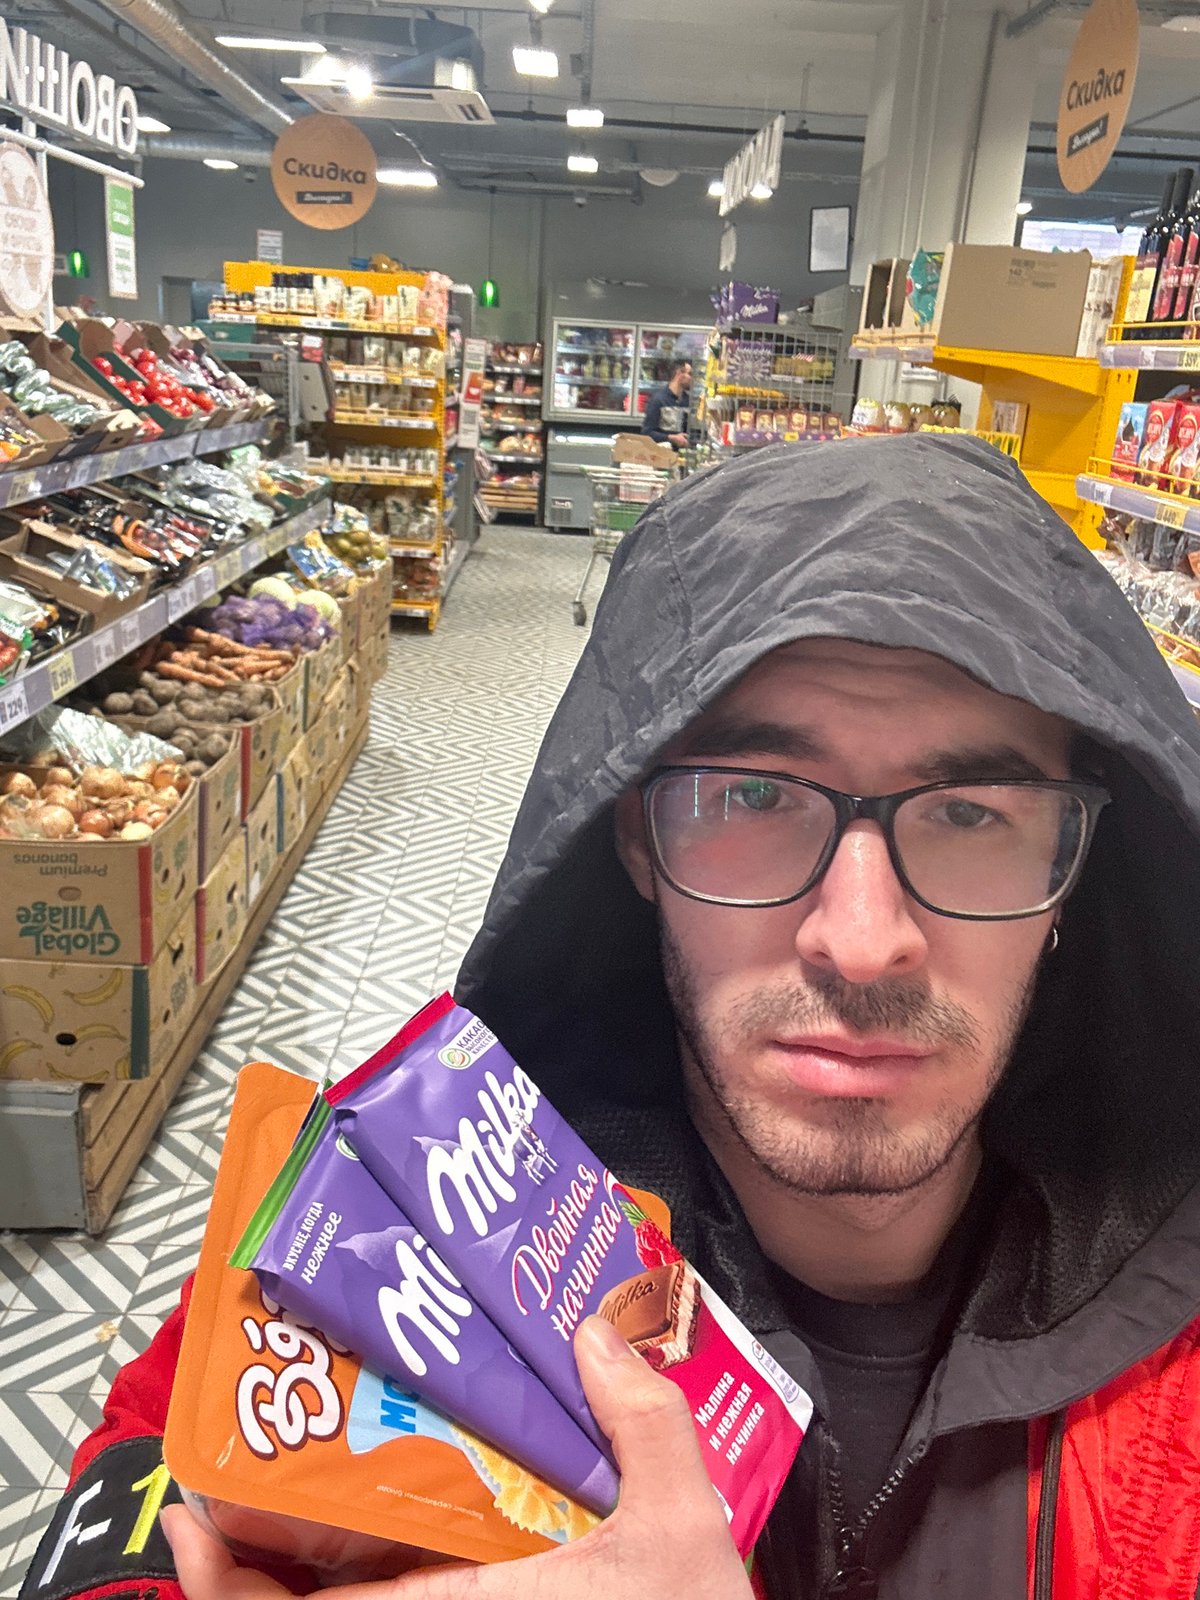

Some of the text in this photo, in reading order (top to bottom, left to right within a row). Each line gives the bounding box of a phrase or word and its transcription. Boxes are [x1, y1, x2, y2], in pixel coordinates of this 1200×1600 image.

[1066, 67, 1126, 111] Скидка
[284, 157, 366, 184] Скидка
[40, 863, 109, 879] Premium
[16, 901, 113, 933] Village
[19, 929, 121, 957] Global
[456, 1020, 486, 1049] КАКАО
[426, 1065, 541, 1237] Milka
[300, 1211, 343, 1285] нежнее
[511, 1164, 600, 1316] Двойная
[550, 1170, 625, 1341] начинка
[600, 1279, 659, 1326] Milka
[694, 1370, 735, 1428] Малина
[708, 1382, 754, 1452] и нежная
[725, 1400, 766, 1466] начинка
